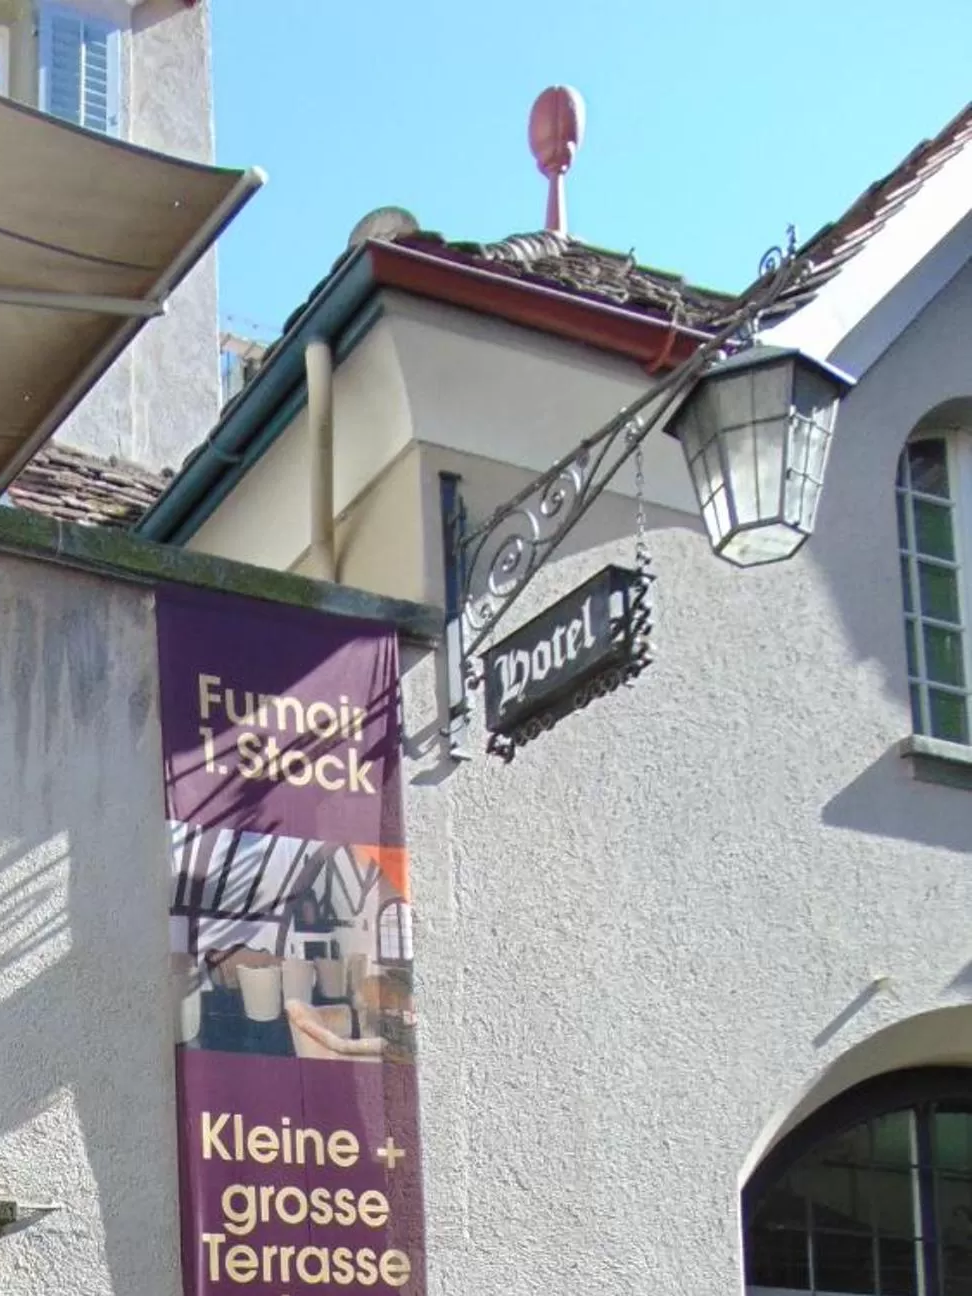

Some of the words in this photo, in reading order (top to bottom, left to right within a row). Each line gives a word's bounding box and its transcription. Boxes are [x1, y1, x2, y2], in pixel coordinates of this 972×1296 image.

[198, 673, 366, 741] Fumoir
[199, 726, 228, 775] 1.
[237, 730, 376, 795] Stock
[201, 1111, 361, 1167] Kleine
[376, 1136, 406, 1169] +
[221, 1183, 390, 1236] grosse
[201, 1232, 412, 1287] Terrasse
